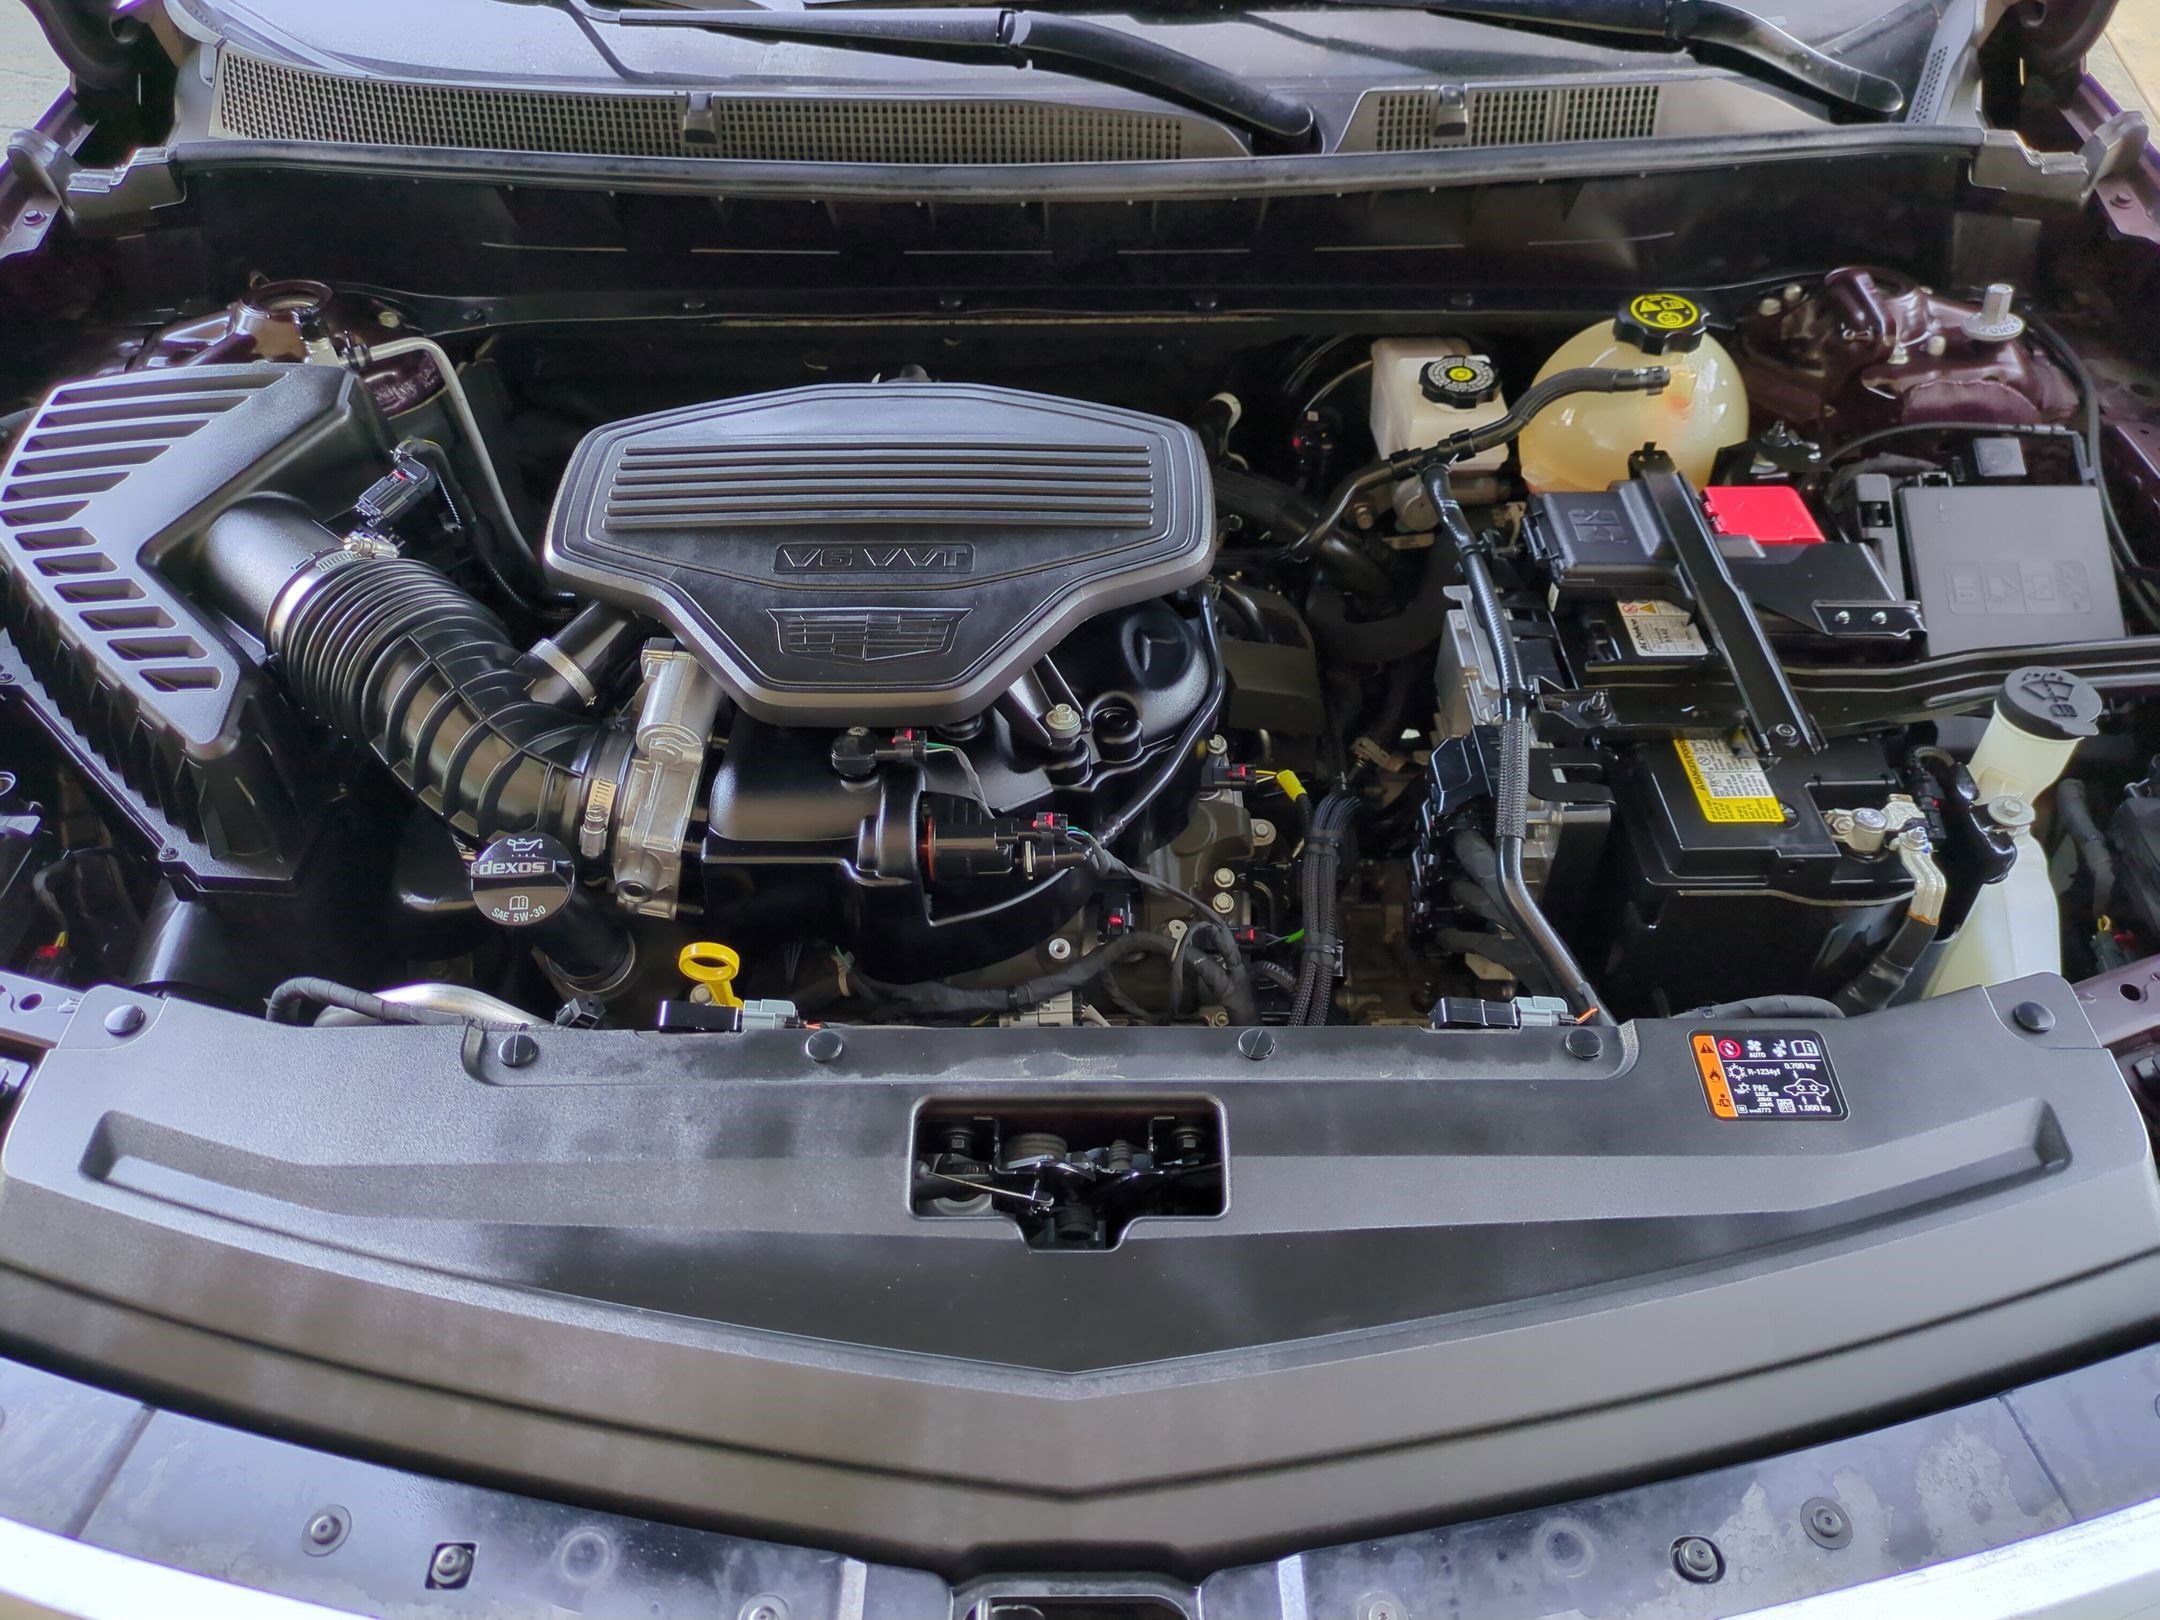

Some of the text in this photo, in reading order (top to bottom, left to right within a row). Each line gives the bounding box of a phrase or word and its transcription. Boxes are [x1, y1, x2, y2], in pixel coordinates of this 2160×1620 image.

[783, 546, 968, 567] V6 VVT
[1687, 758, 1705, 784] DANGER
[479, 860, 545, 875] dexos
[491, 905, 546, 922] SAE 5W-30
[1747, 1068, 1781, 1077] R-1234yf
[1805, 1063, 1816, 1071] kg
[1752, 1084, 1770, 1092] PAG
[1798, 1104, 1832, 1113] 1.000 kg
